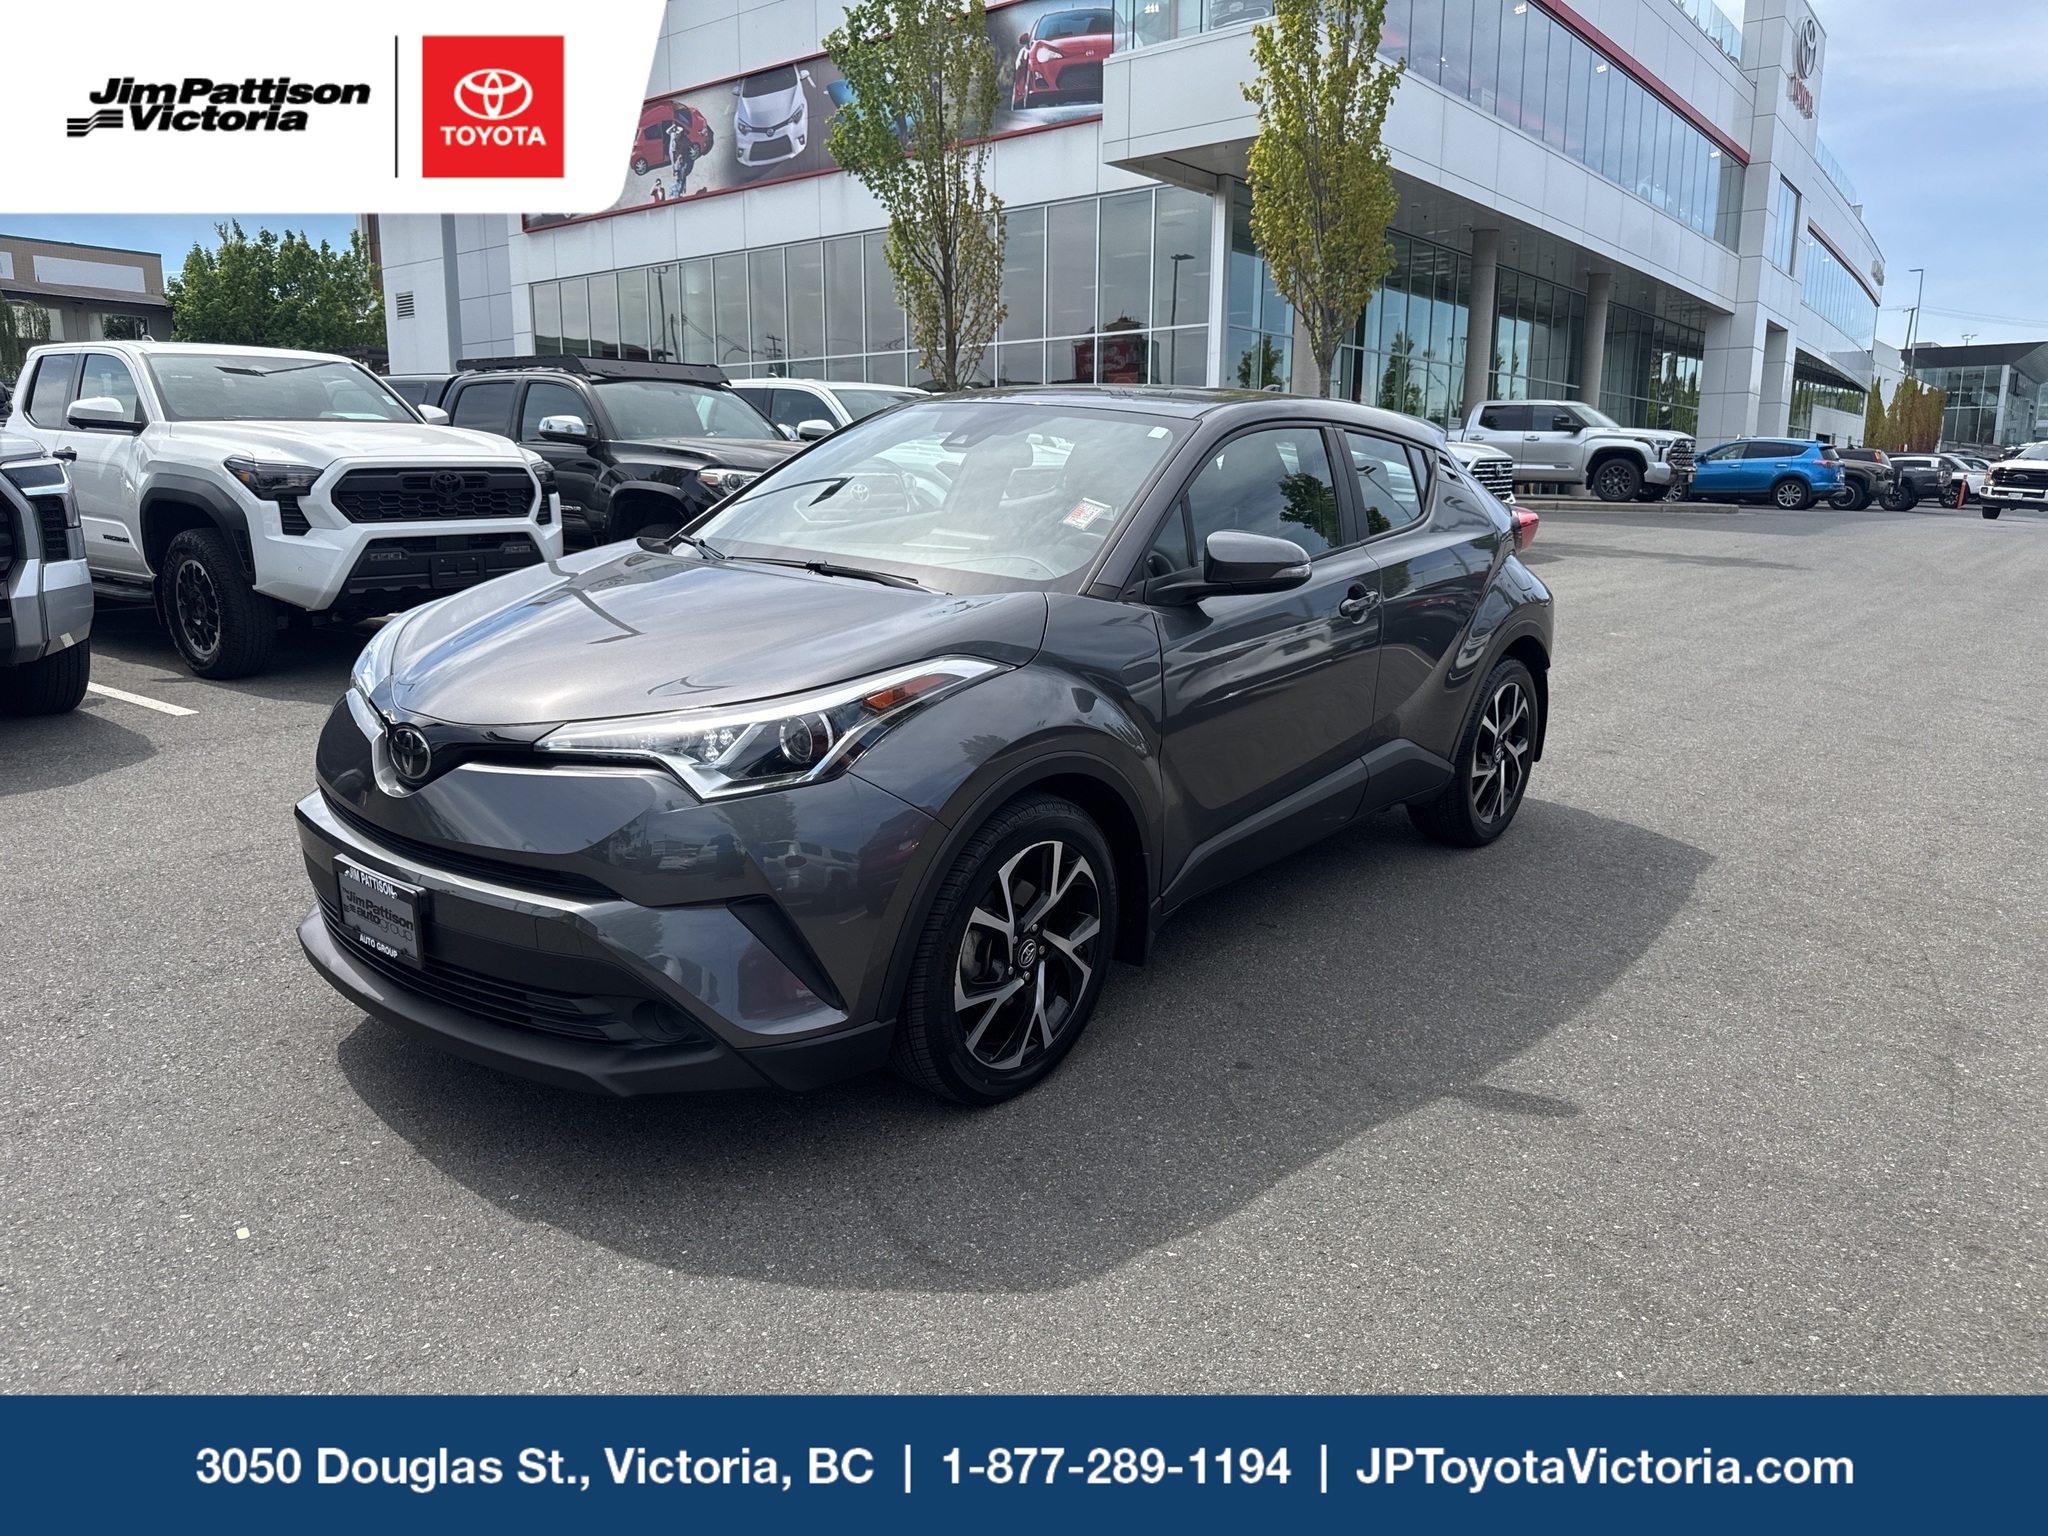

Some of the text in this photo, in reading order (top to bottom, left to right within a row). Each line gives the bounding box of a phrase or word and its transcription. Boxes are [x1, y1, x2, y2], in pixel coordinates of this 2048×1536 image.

[349, 866, 394, 897] JIM PATTISON
[360, 933, 398, 958] AUTO GROUP
